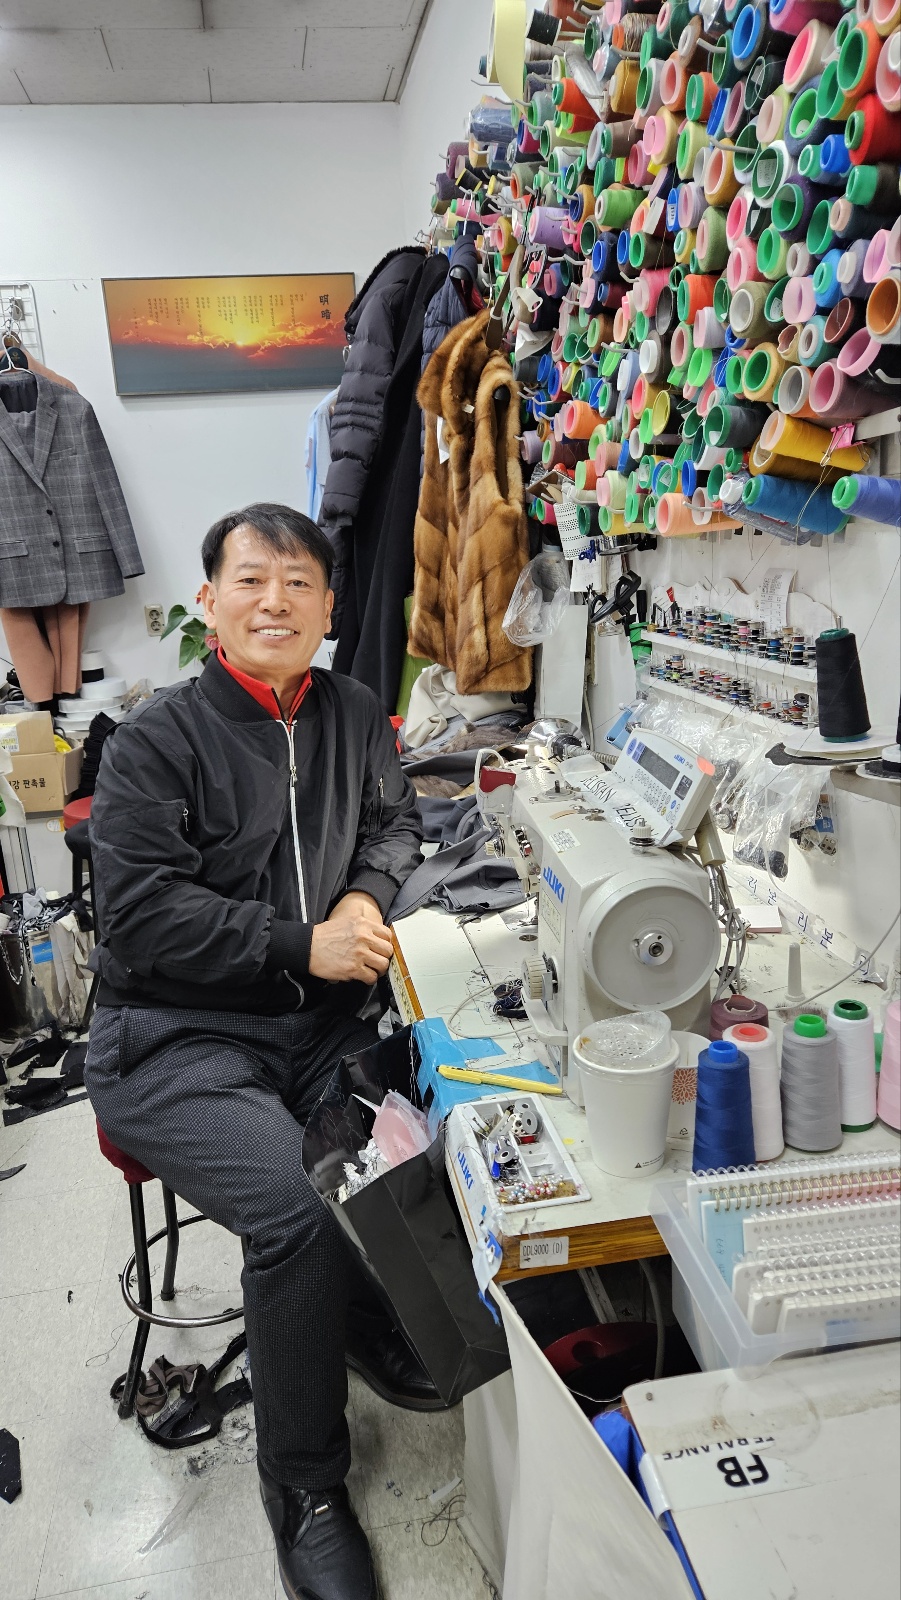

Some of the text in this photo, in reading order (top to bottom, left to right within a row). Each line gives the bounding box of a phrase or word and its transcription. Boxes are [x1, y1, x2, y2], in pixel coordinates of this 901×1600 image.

[9, 778, 46, 790] 강 판촉물
[543, 866, 564, 904] JUKI
[458, 1151, 474, 1190] JUKI
[717, 1453, 769, 1488] FB
